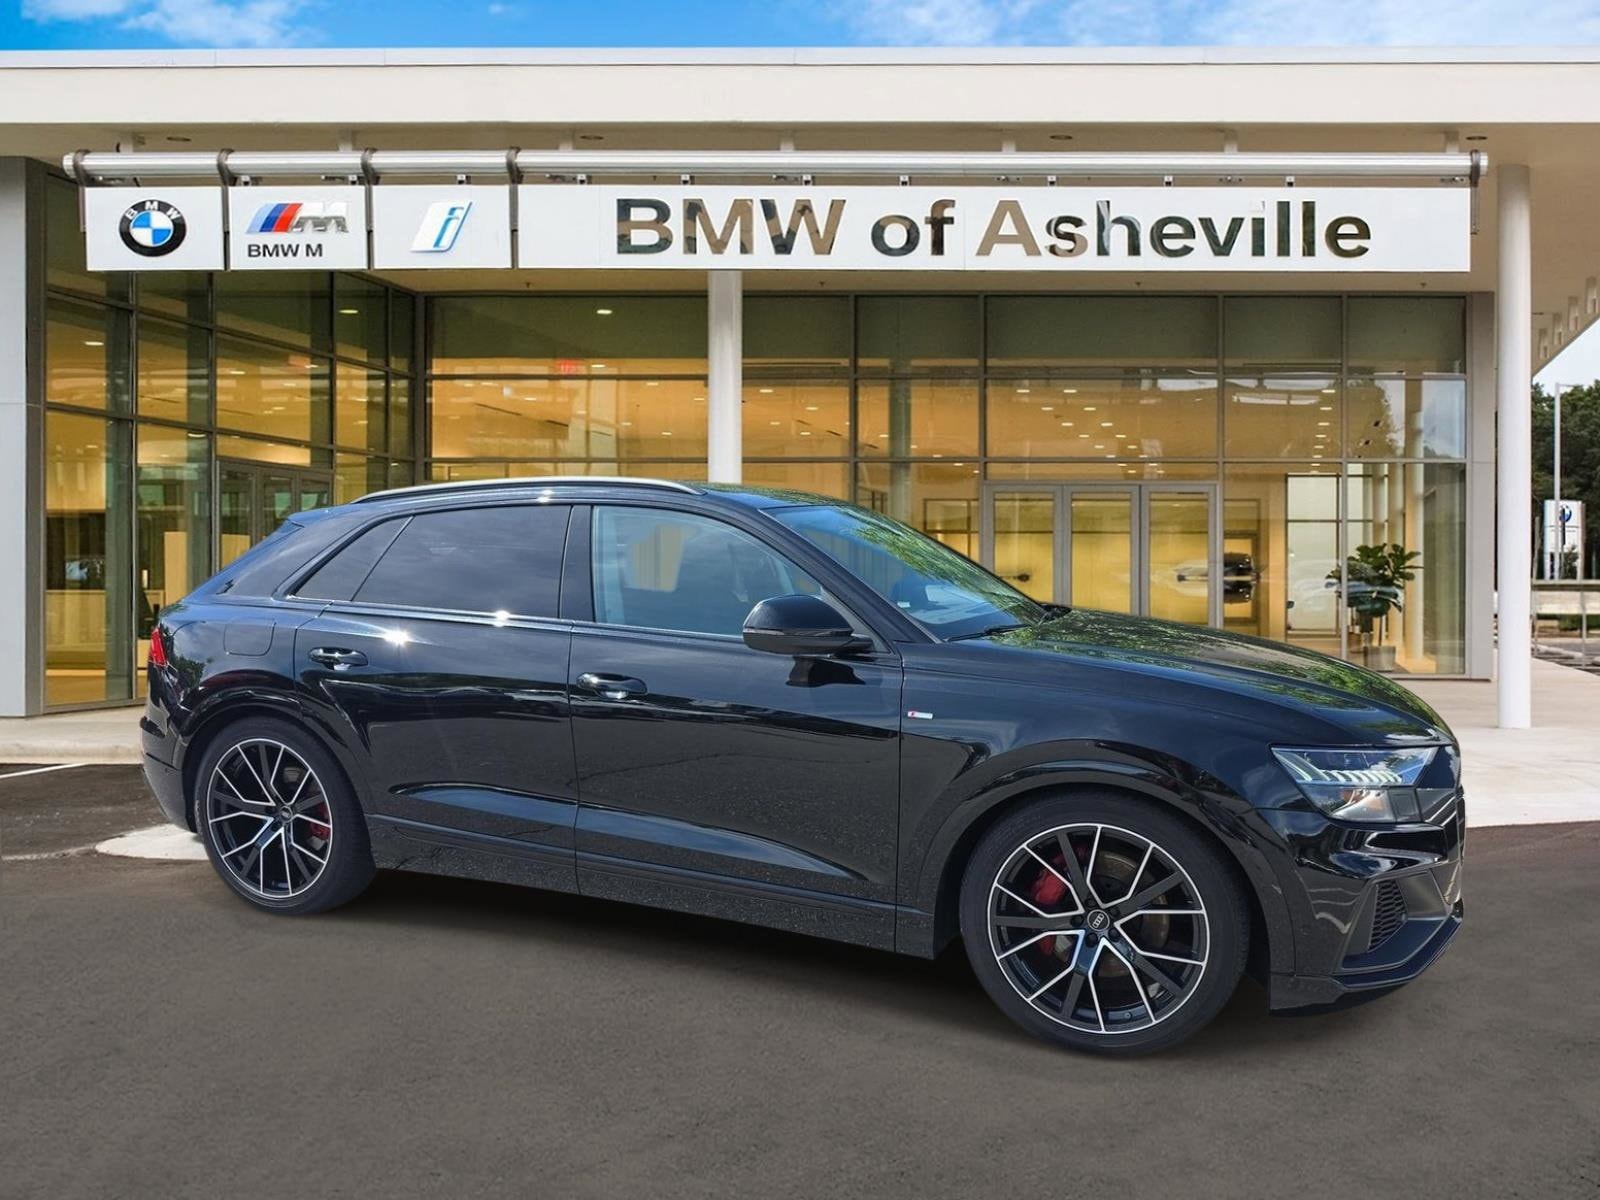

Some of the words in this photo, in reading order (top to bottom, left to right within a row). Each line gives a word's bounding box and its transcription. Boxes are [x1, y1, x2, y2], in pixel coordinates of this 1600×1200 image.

[125, 201, 181, 220] BMW
[616, 198, 846, 256] BMW
[870, 199, 956, 257] of
[975, 199, 1372, 259] Asheville
[247, 243, 300, 258] BMW
[305, 243, 323, 258] M
